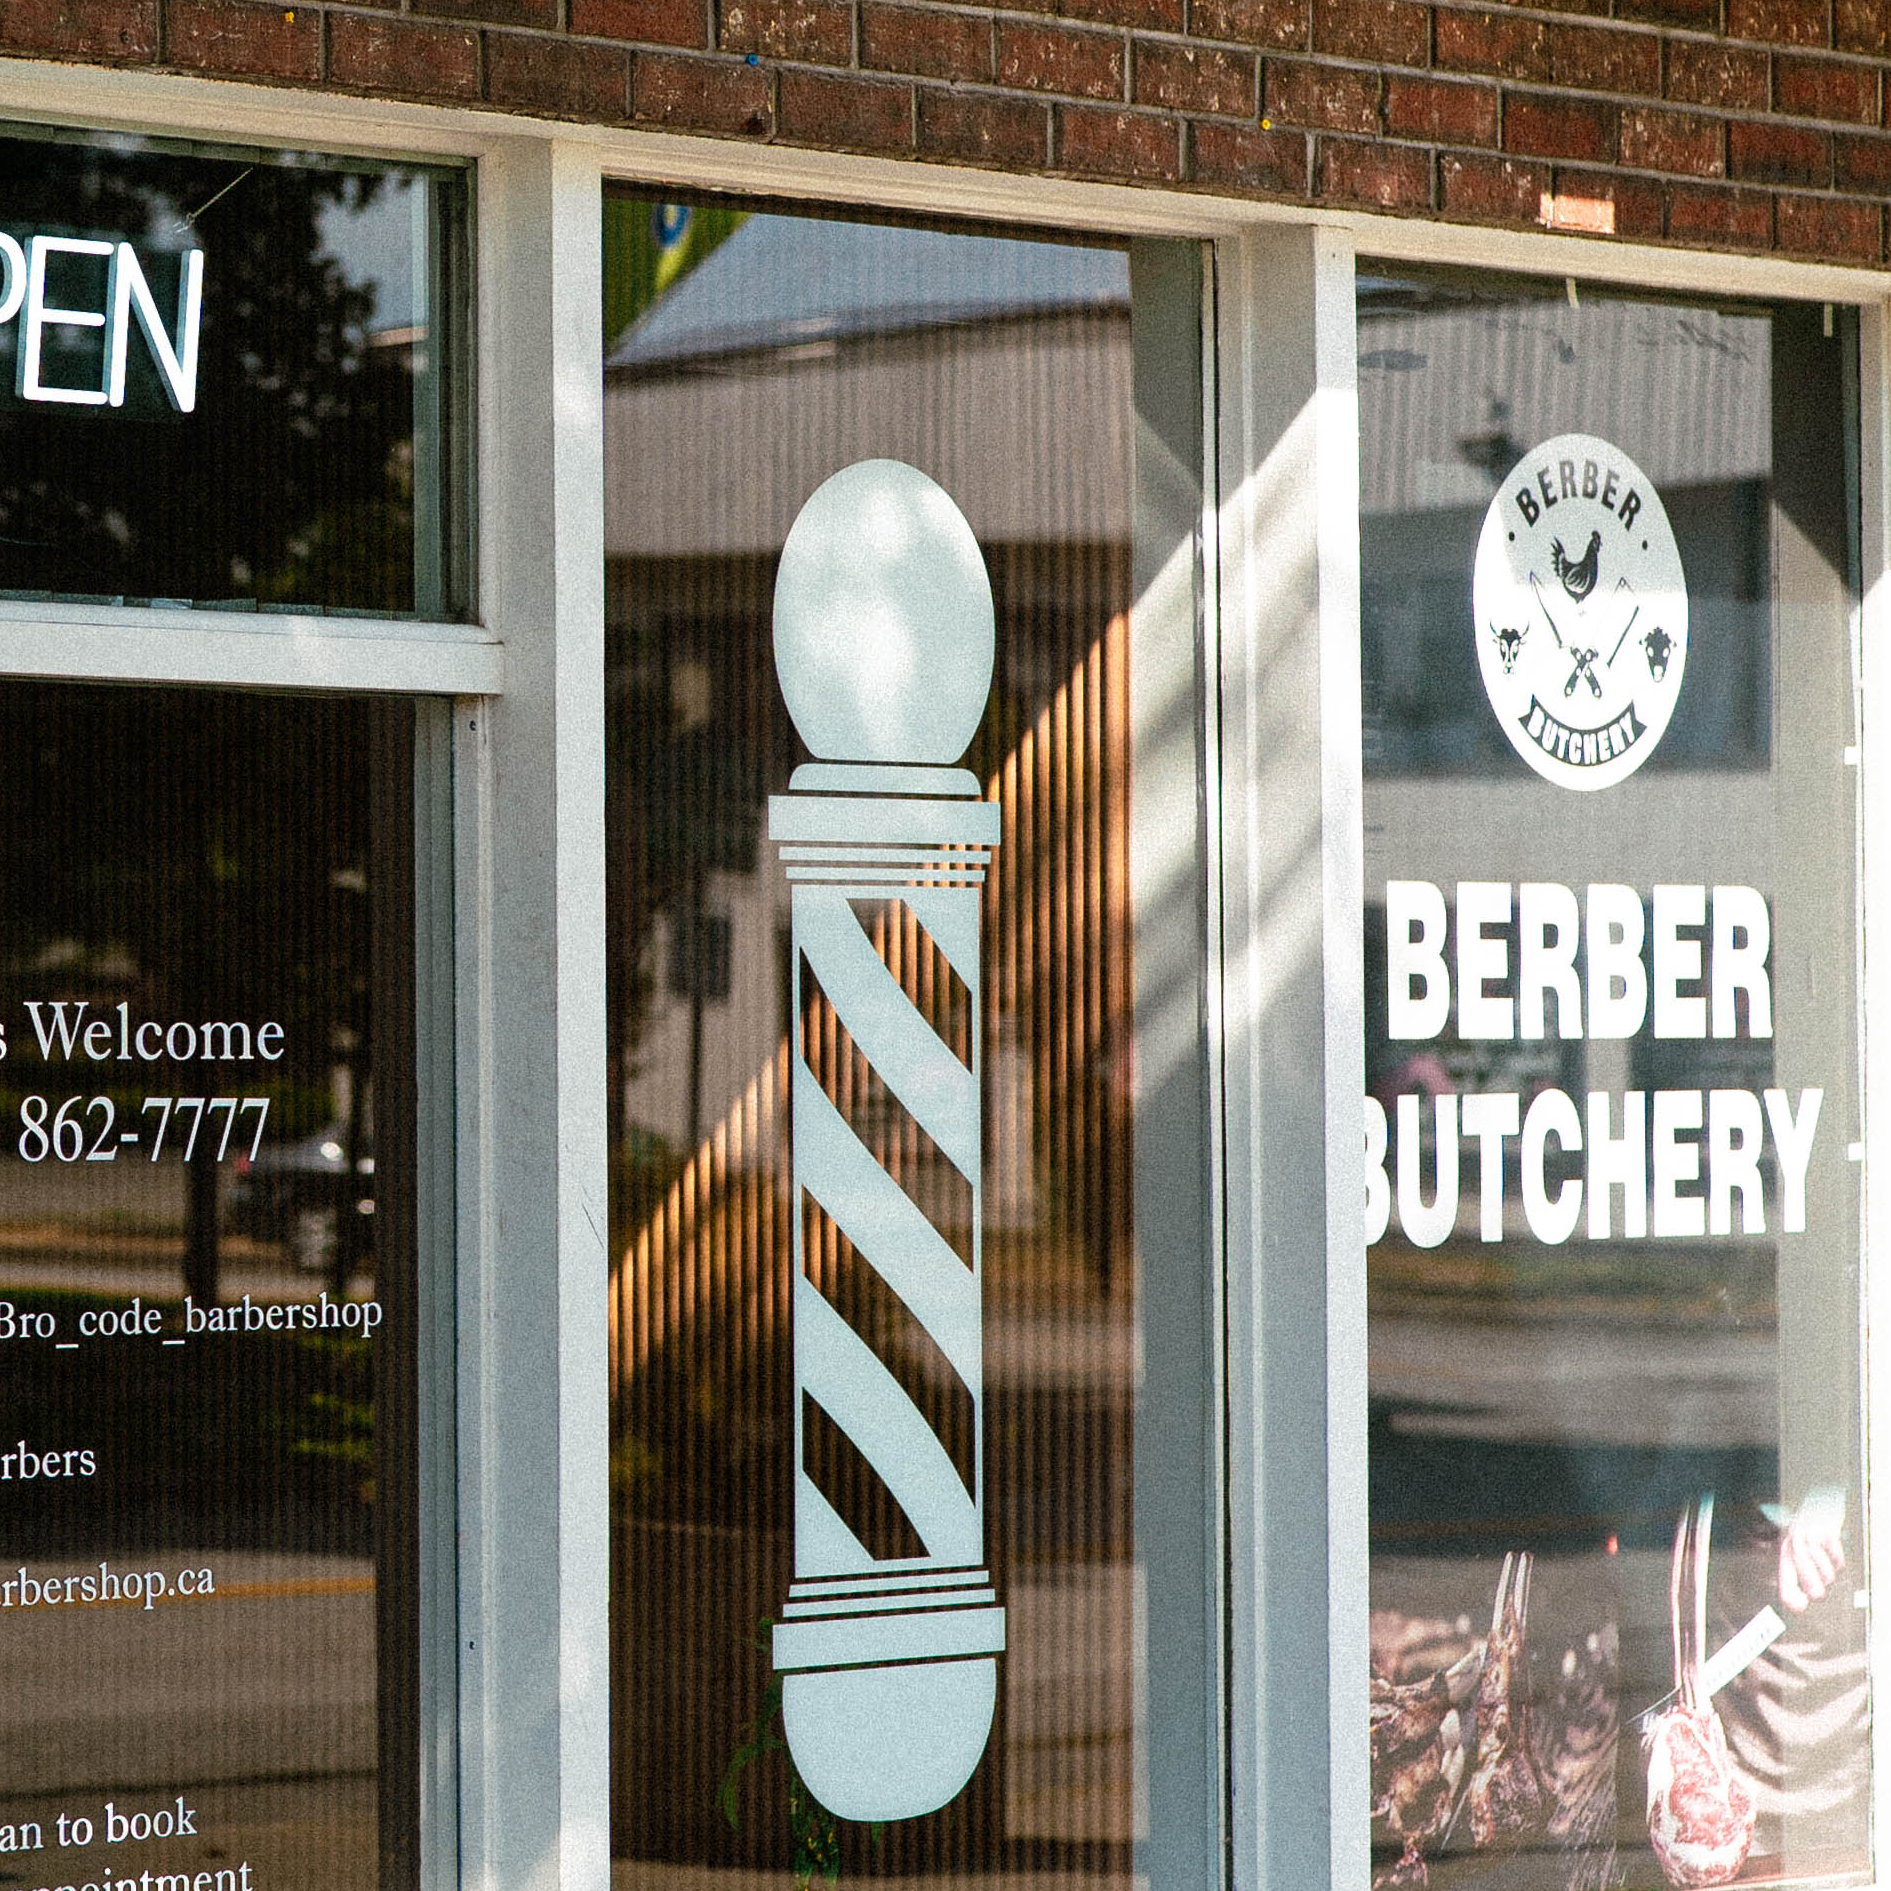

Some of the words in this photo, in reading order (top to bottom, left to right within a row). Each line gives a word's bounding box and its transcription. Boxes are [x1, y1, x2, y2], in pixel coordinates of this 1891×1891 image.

[1515, 458, 1642, 532] BERBER
[1526, 708, 1638, 766] BUTCHERY
[1385, 879, 1774, 1040] BERBER
[23, 1000, 285, 1062] Welcome
[18, 1094, 271, 1163] 862-7777
[56, 1813, 94, 1848] to
[105, 1795, 197, 1844] book
